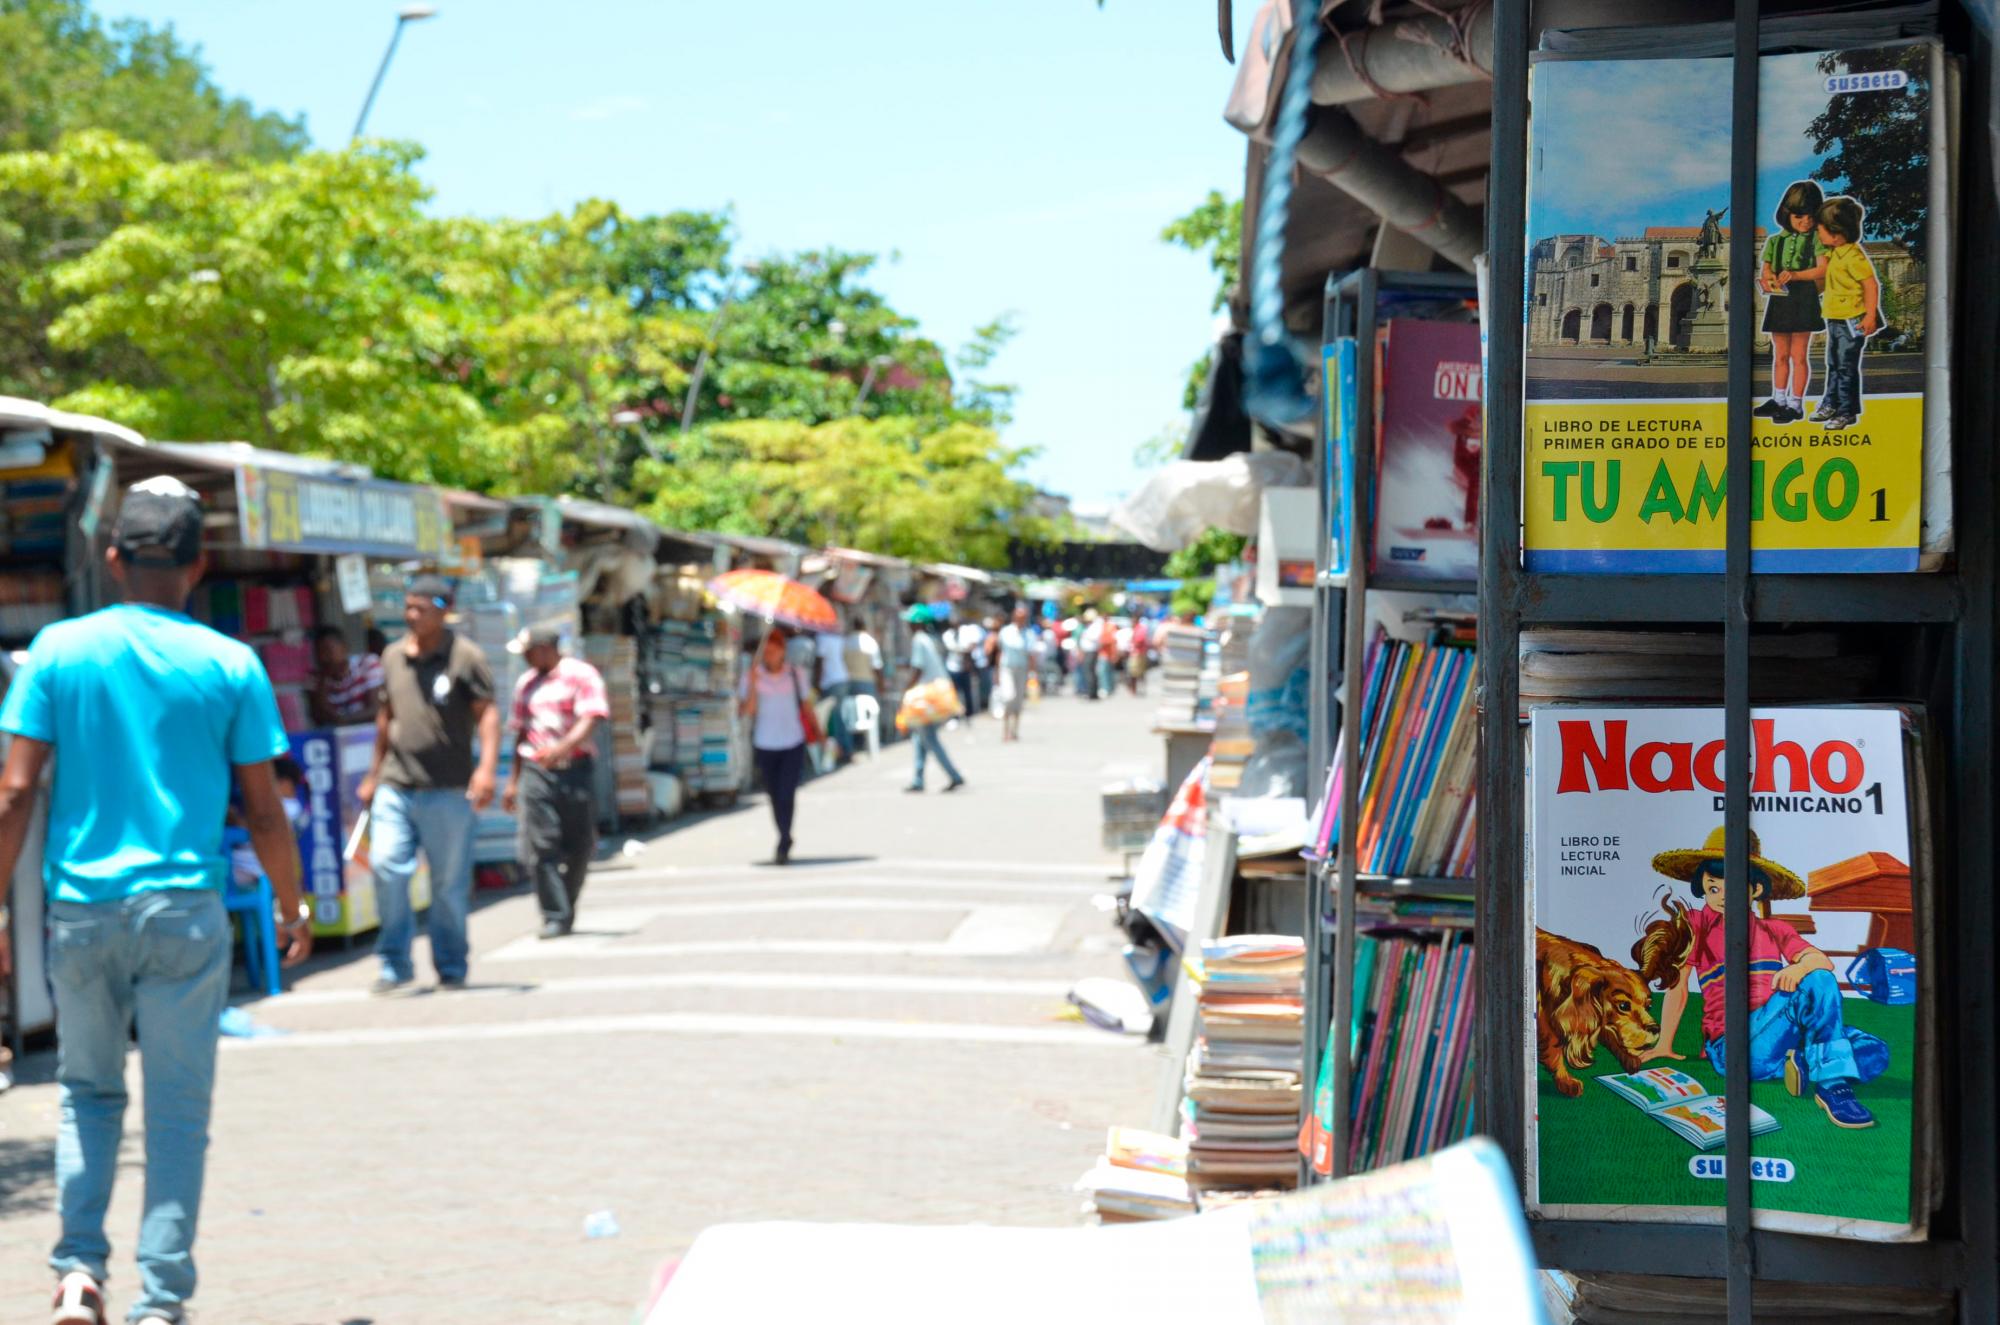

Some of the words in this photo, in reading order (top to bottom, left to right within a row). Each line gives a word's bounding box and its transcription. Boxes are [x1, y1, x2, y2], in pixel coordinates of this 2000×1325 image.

[1828, 73, 1901, 92] susaeta
[1438, 369, 1469, 400] ON
[1544, 420, 1593, 432] LIBRO
[1599, 420, 1620, 432] DE
[1627, 419, 1703, 432] LECTURA
[1544, 438, 1605, 450] PRIMER
[1611, 437, 1670, 449] GRADO
[1676, 437, 1698, 449] DE
[1704, 432, 1802, 449] EDACIÓN
[1809, 432, 1872, 447] BÁSICA
[1541, 459, 1621, 524] TU
[1868, 487, 1892, 522] 1
[1713, 796, 1862, 814] DMINICANO
[1865, 782, 1884, 815] 1
[1561, 836, 1600, 847] LIBRO
[1603, 836, 1621, 846] DE
[1561, 851, 1621, 861] LECTURA
[1561, 865, 1607, 876] INICIAL
[1695, 1158, 1787, 1179] sueta
